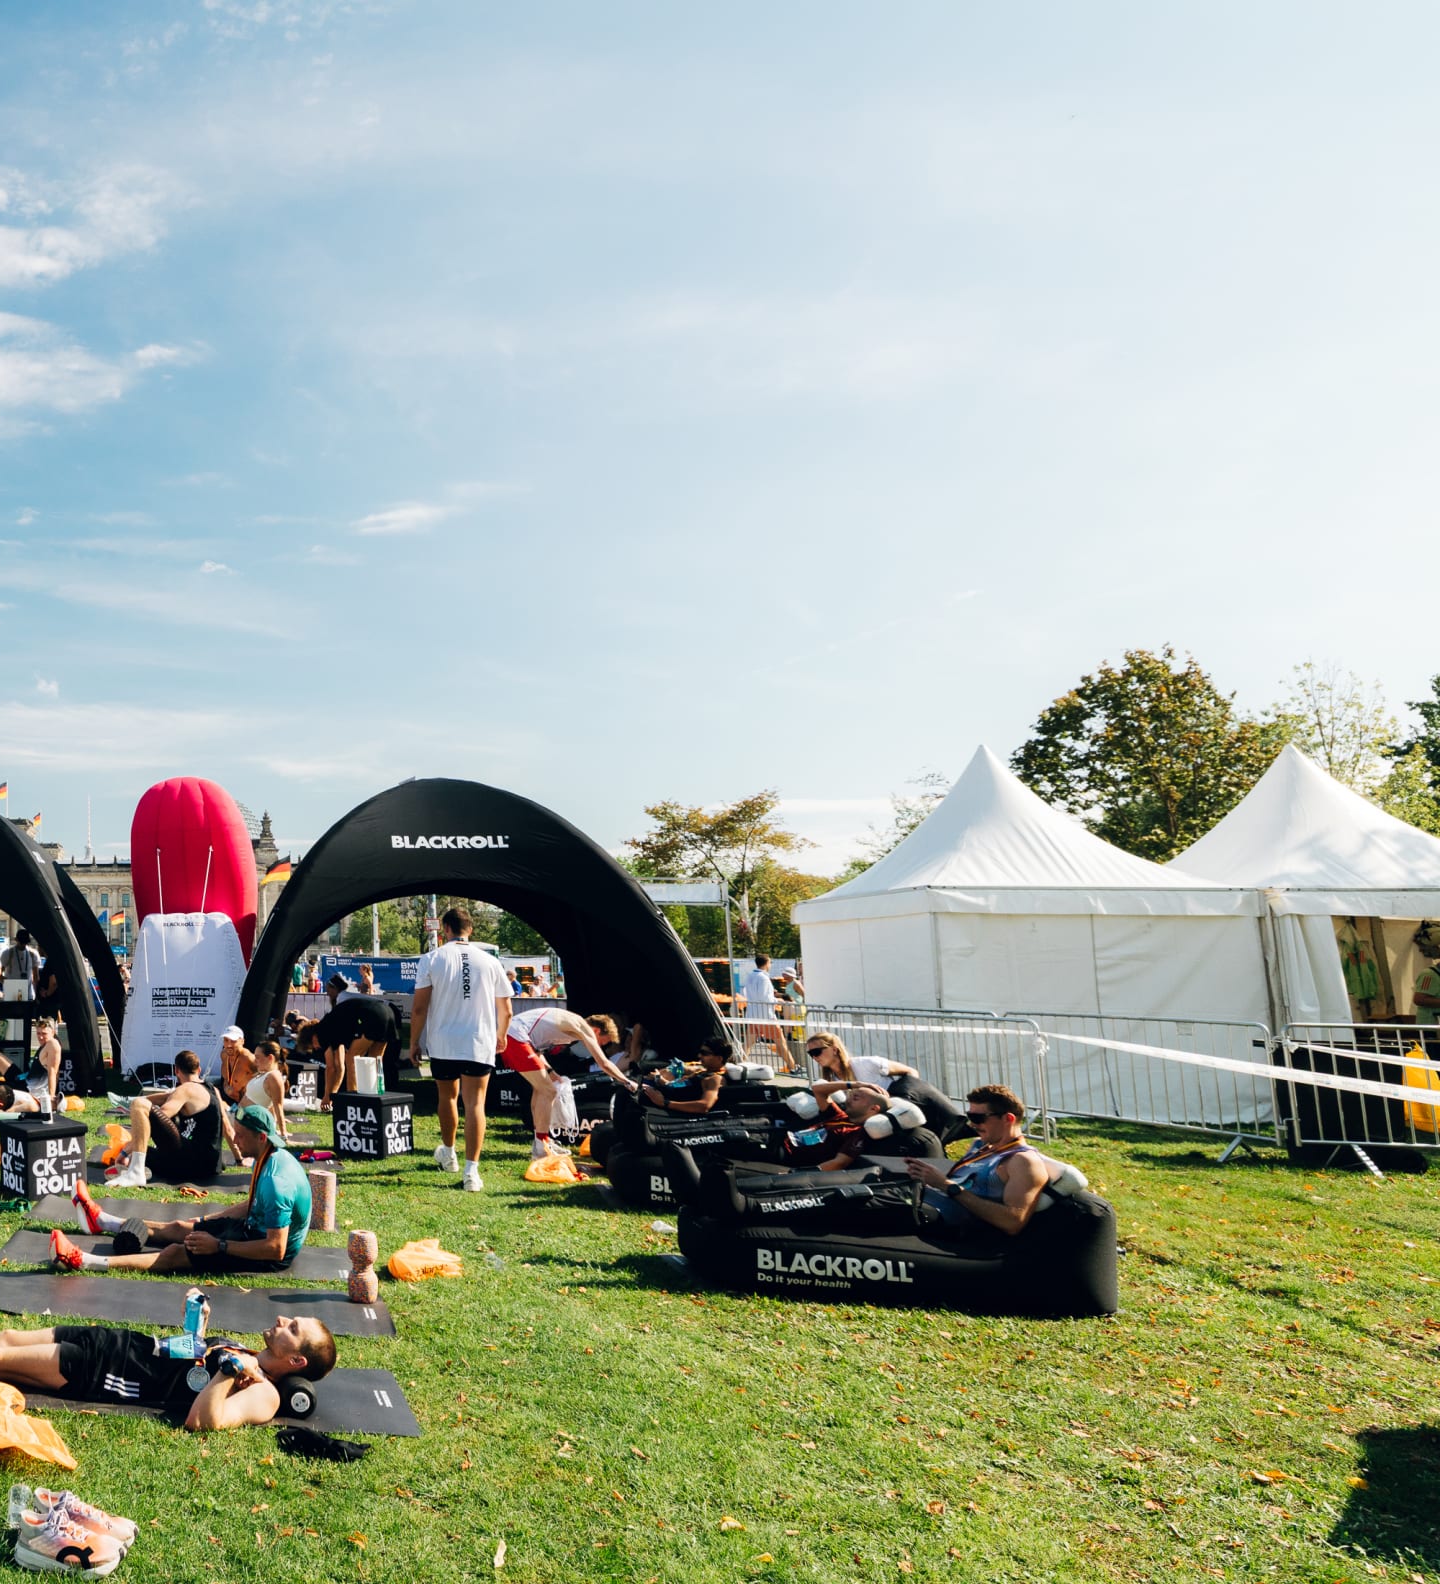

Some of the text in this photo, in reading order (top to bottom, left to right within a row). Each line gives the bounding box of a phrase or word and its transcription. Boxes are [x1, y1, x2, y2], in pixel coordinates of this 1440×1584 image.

[391, 835, 509, 849] BLACKROLL
[461, 953, 471, 1001] BLACKROLL
[347, 1106, 377, 1124] BLA
[392, 1105, 411, 1122] BLA
[336, 1120, 357, 1137] CK
[385, 1123, 399, 1139] CK
[7, 1137, 25, 1160] BLA
[46, 1137, 82, 1159] BLA
[339, 1135, 378, 1155] ROLL
[388, 1136, 412, 1154] ROLL
[1, 1151, 13, 1172] CK
[32, 1158, 58, 1177] CK
[3, 1171, 25, 1195] ROLL
[757, 1248, 913, 1284] BLACKROLL
[757, 1272, 851, 1289] Do it your health
